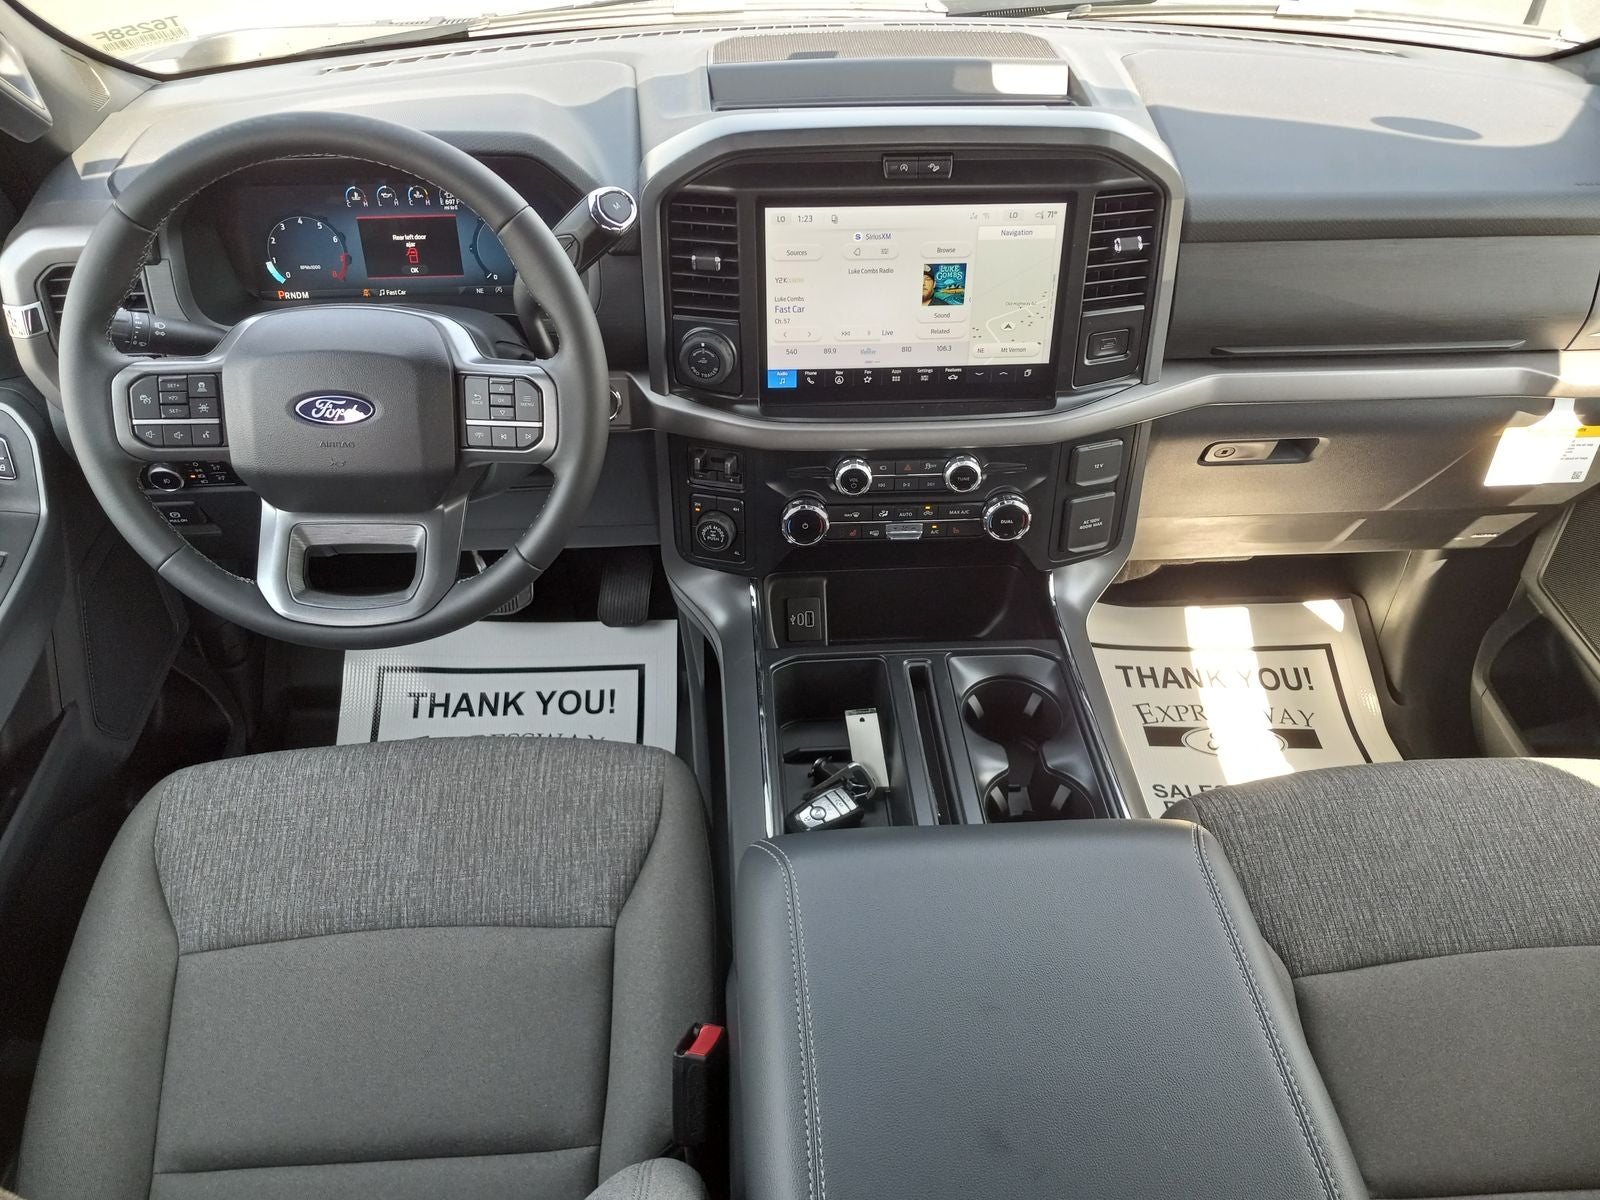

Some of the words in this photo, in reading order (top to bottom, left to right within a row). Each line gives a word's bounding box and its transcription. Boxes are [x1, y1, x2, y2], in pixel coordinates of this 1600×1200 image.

[1047, 210, 1058, 218] 71°
[297, 217, 303, 225] 4
[798, 215, 813, 223] 1:23
[280, 223, 286, 231] 3
[317, 221, 323, 230] 5
[270, 237, 276, 245] 2
[332, 235, 338, 243] 6
[940, 264, 960, 273] LUKE
[774, 306, 790, 314] Fast
[792, 306, 806, 314] Car
[1115, 665, 1227, 690] THANK
[1236, 666, 1315, 691] YOU!
[408, 690, 525, 720] THANK
[536, 688, 617, 716] YOU!
[1132, 703, 1315, 729] EXPRWAY
